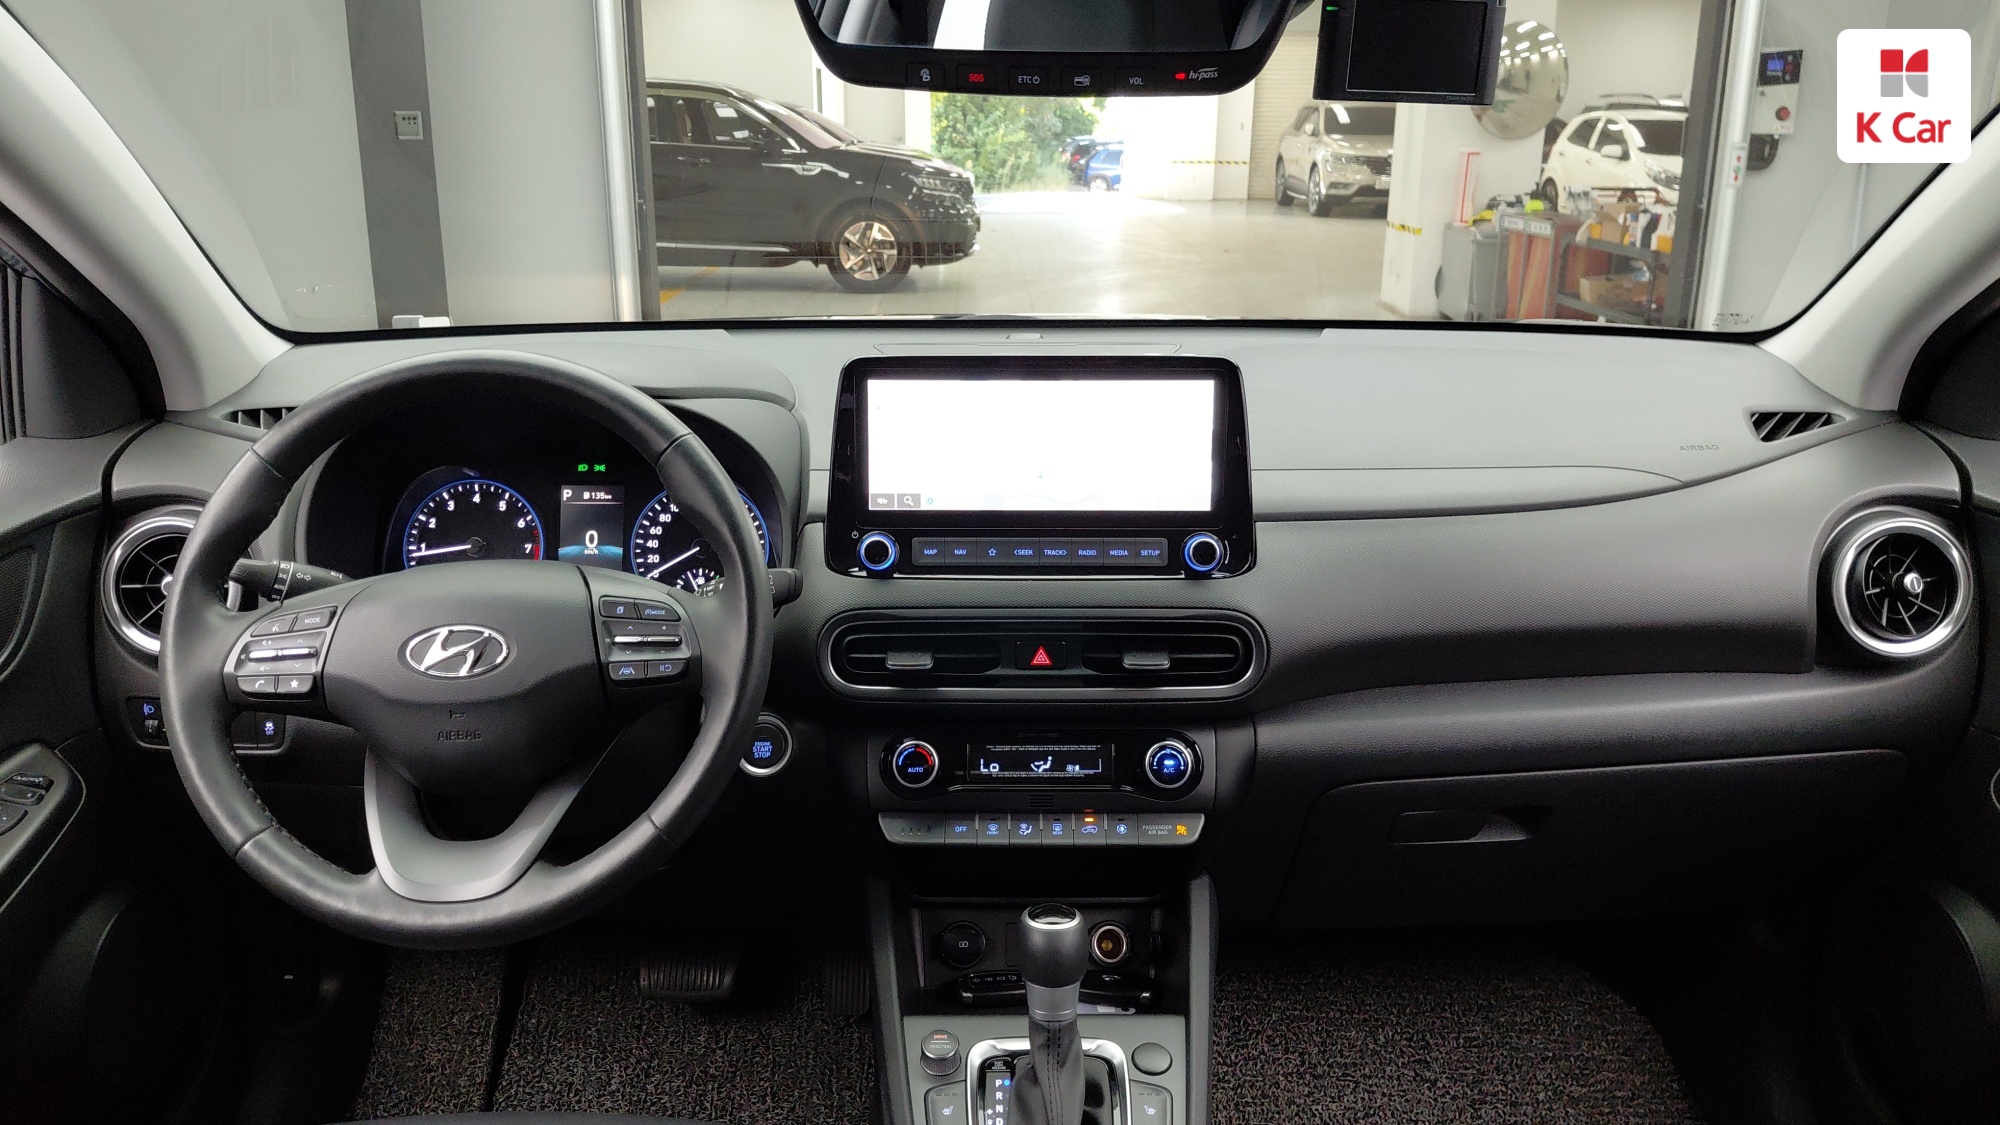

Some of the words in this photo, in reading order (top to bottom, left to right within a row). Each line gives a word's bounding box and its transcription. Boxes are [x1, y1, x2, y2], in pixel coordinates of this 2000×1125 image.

[968, 73, 985, 82] SOS
[1018, 75, 1032, 84] ETC
[1129, 76, 1144, 85] VOL
[472, 492, 481, 504] 4
[562, 489, 573, 502] P
[447, 500, 455, 511] 3
[498, 500, 507, 512] 5
[428, 517, 436, 529] 2
[658, 514, 672, 523] 80
[517, 518, 526, 529] 6
[649, 526, 663, 535] 60
[585, 530, 599, 549] 0
[646, 539, 659, 548] 40
[420, 542, 426, 553] 1
[524, 543, 533, 554] 7
[923, 548, 938, 556] MAP
[954, 548, 967, 556] NAV
[647, 554, 660, 563] 20
[304, 616, 321, 624] MODE
[437, 730, 483, 742] AIRBAG
[754, 751, 771, 759] STOP
[954, 825, 968, 833] OFF
[995, 1079, 1003, 1088] P
[995, 1091, 1003, 1101] R
[995, 1104, 1004, 1114] N
[995, 1117, 1004, 1125] D
